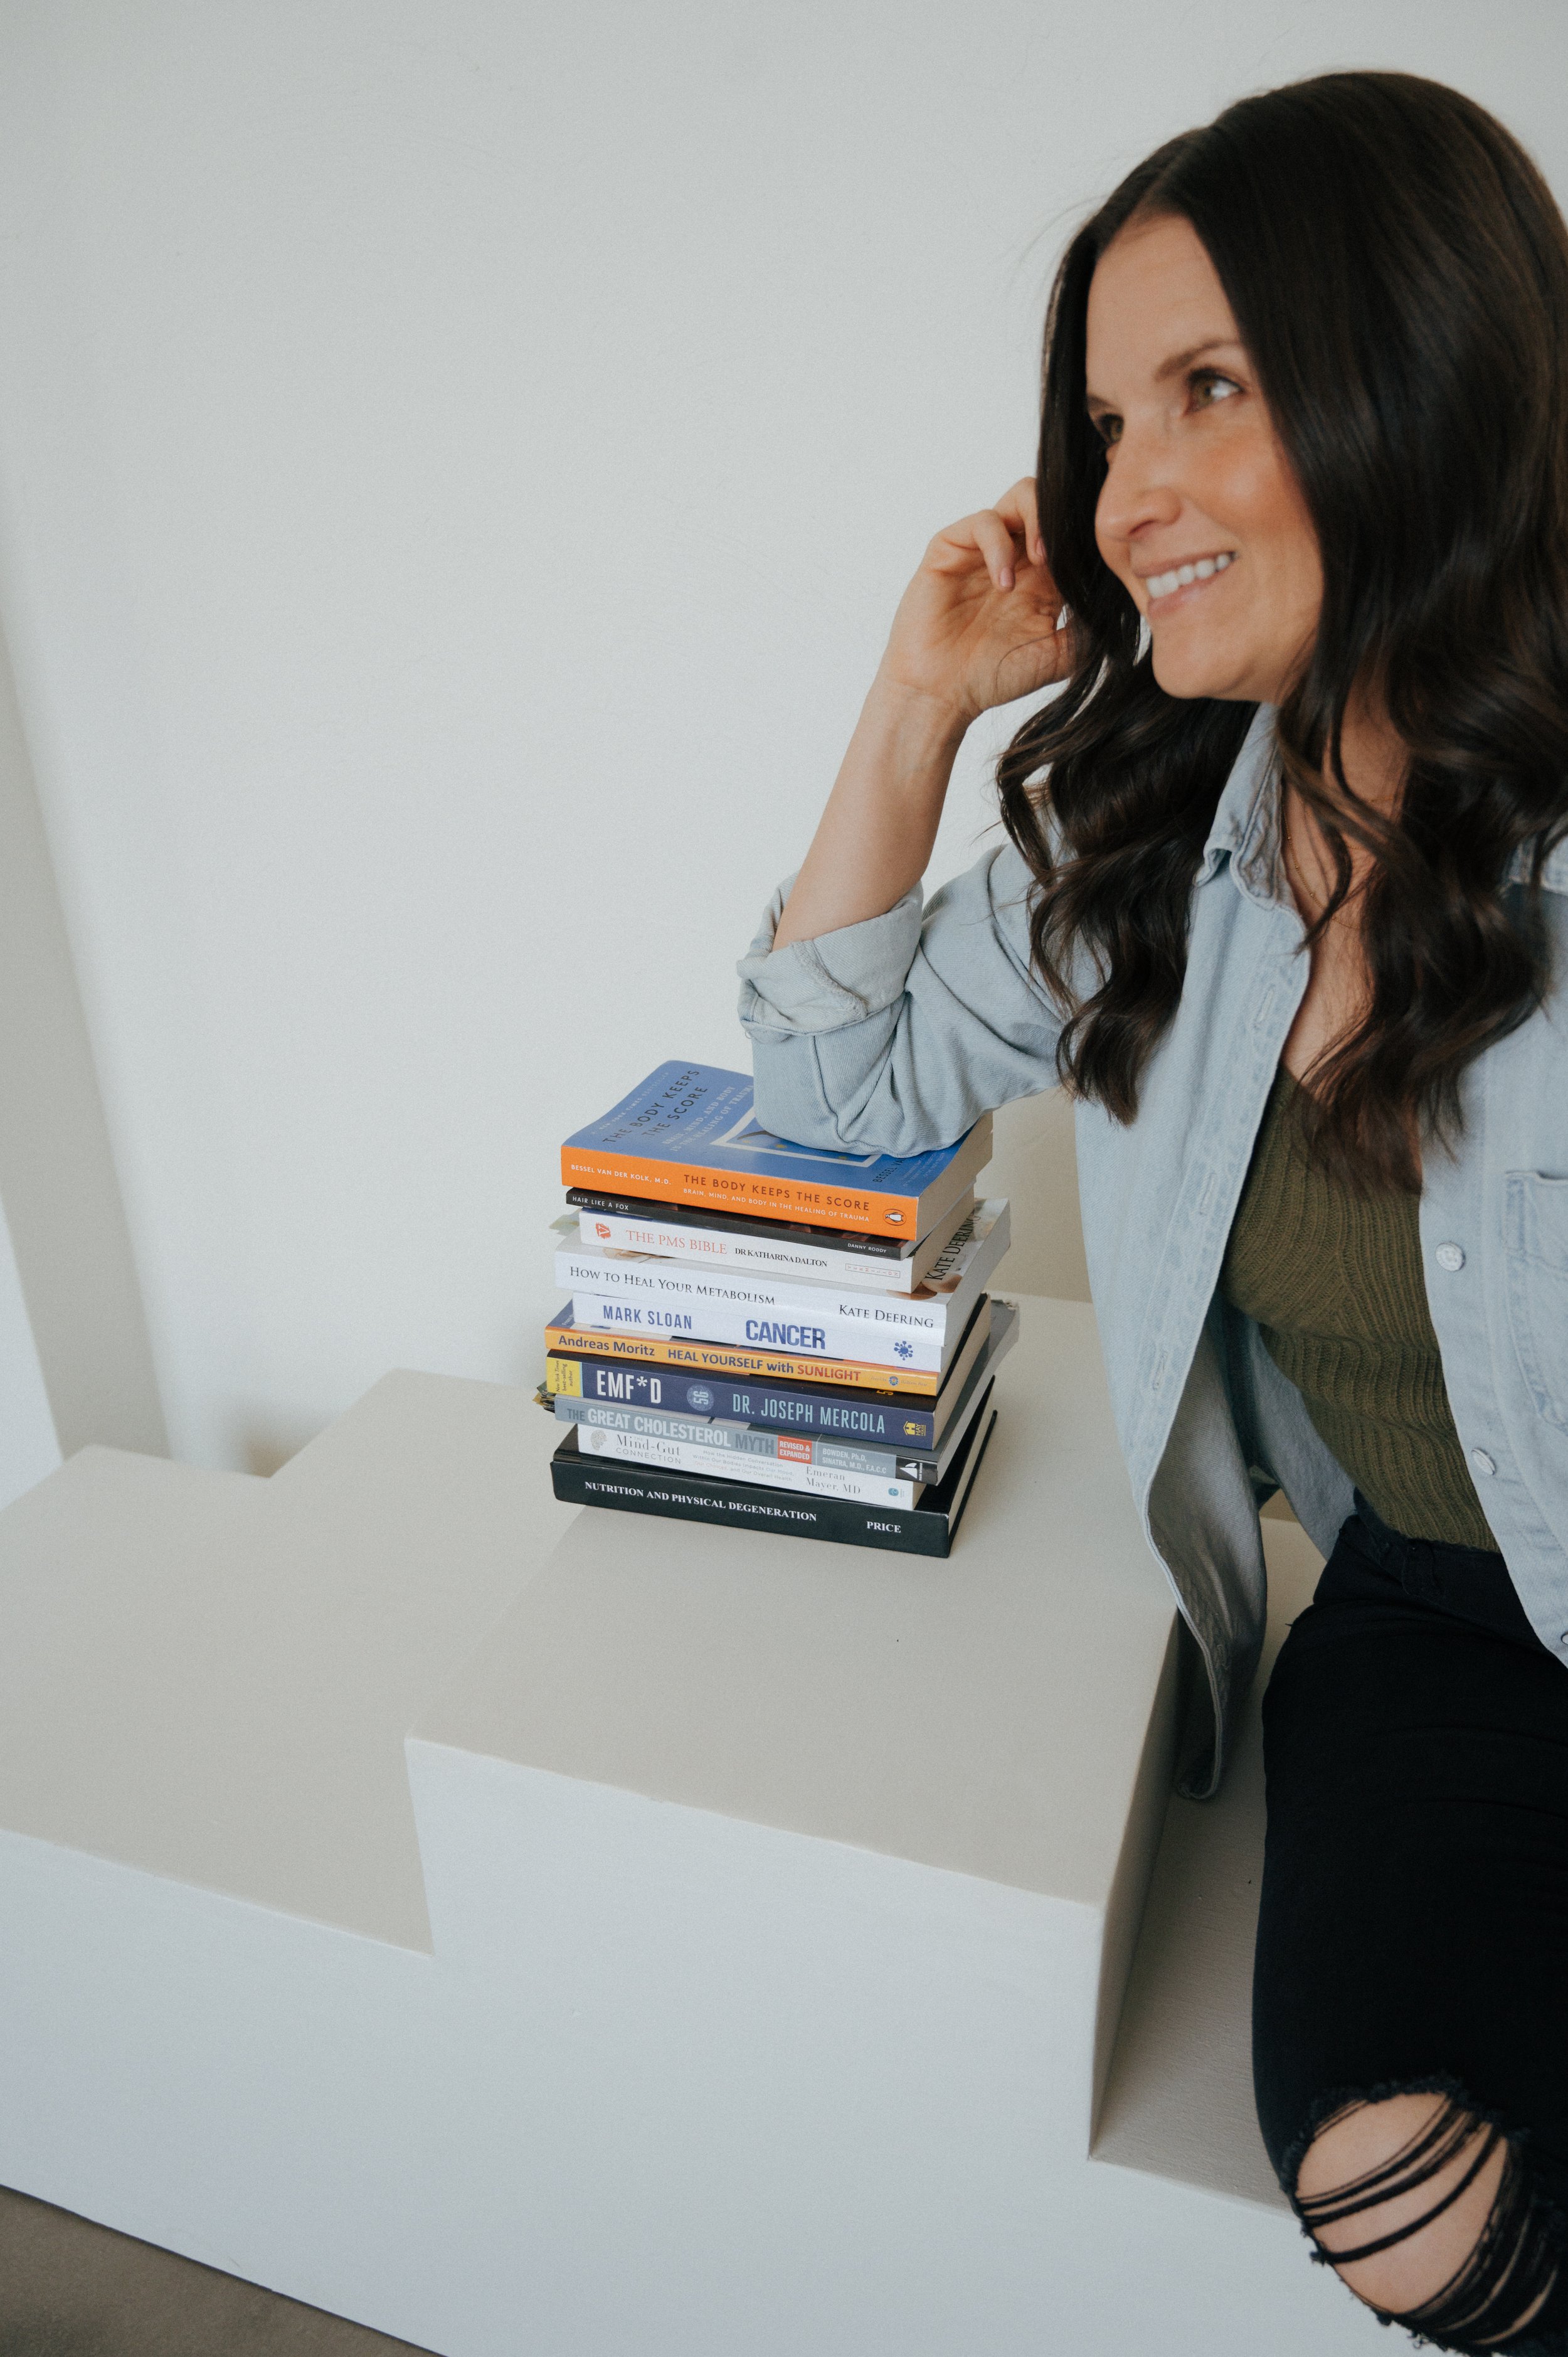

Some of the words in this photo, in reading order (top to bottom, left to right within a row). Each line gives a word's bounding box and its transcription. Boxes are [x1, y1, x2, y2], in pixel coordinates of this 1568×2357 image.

[603, 1129, 632, 1142] THE
[629, 1102, 664, 1127] BODY
[662, 1070, 700, 1099] KEEPS
[704, 1102, 719, 1115] AND
[716, 1086, 736, 1101] BODY
[721, 1105, 732, 1115] OF
[642, 1123, 671, 1136] THE
[667, 1087, 707, 1120] SCORE
[571, 1164, 595, 1173] BESSEL
[630, 1174, 652, 1183] KOLK,
[655, 1177, 671, 1185] M.D.
[872, 1168, 898, 1183] BESSEL
[684, 1174, 706, 1186] THE
[712, 1178, 746, 1191] BODY
[752, 1184, 790, 1198] KEEPS
[797, 1191, 820, 1203] THE
[827, 1196, 869, 1211] SCORE
[573, 1196, 588, 1204] HAIR
[615, 1203, 629, 1211] FOX
[684, 1188, 706, 1196] BRAIN,
[709, 1192, 729, 1200] MIND,
[795, 1205, 826, 1216] HEALING
[840, 1212, 869, 1222] TRAUMA
[626, 1230, 655, 1243] THE
[658, 1235, 685, 1248] PMS
[689, 1239, 728, 1255] BIBLE
[924, 1257, 955, 1280] KATE
[942, 1214, 981, 1255] DEERING
[748, 1250, 794, 1263] KATHARINA
[795, 1257, 828, 1267] DALTON
[603, 1305, 642, 1323] MARK
[648, 1311, 692, 1329] SLOAN
[746, 1319, 825, 1349] CANCER
[559, 1335, 610, 1350] Andreas
[613, 1341, 655, 1356] Moritz
[668, 1349, 699, 1361] HEAL
[702, 1353, 763, 1370] YOURSELF
[766, 1362, 793, 1373] with
[797, 1365, 861, 1381] SUNLIGHT
[693, 1390, 709, 1405] 5G
[733, 1393, 755, 1415] DR.
[761, 1398, 813, 1423] JOSEPH
[820, 1407, 885, 1434] MERCOLA
[567, 1408, 585, 1422] THE
[588, 1408, 630, 1429] GREAT
[634, 1416, 731, 1447] CHOLESTEROL
[735, 1434, 774, 1454] MYTH
[617, 1434, 679, 1455] Mind-Gut
[780, 1441, 804, 1451] REVISED
[780, 1450, 810, 1460] EXPANDED
[822, 1448, 850, 1460] BOWDEN,
[616, 1447, 681, 1464] CONNECTION
[748, 1457, 783, 1467] Conversation
[822, 1457, 848, 1467] SINATRA,
[743, 1463, 764, 1471] Impacts
[807, 1466, 845, 1481] Emeran
[843, 1484, 861, 1494] MD
[585, 1481, 644, 1497] NUTRITION
[647, 1491, 669, 1501] AND
[672, 1494, 726, 1508] PHYSICAL
[728, 1501, 817, 1521] DEGENERATION
[867, 1521, 901, 1533] PRICE
